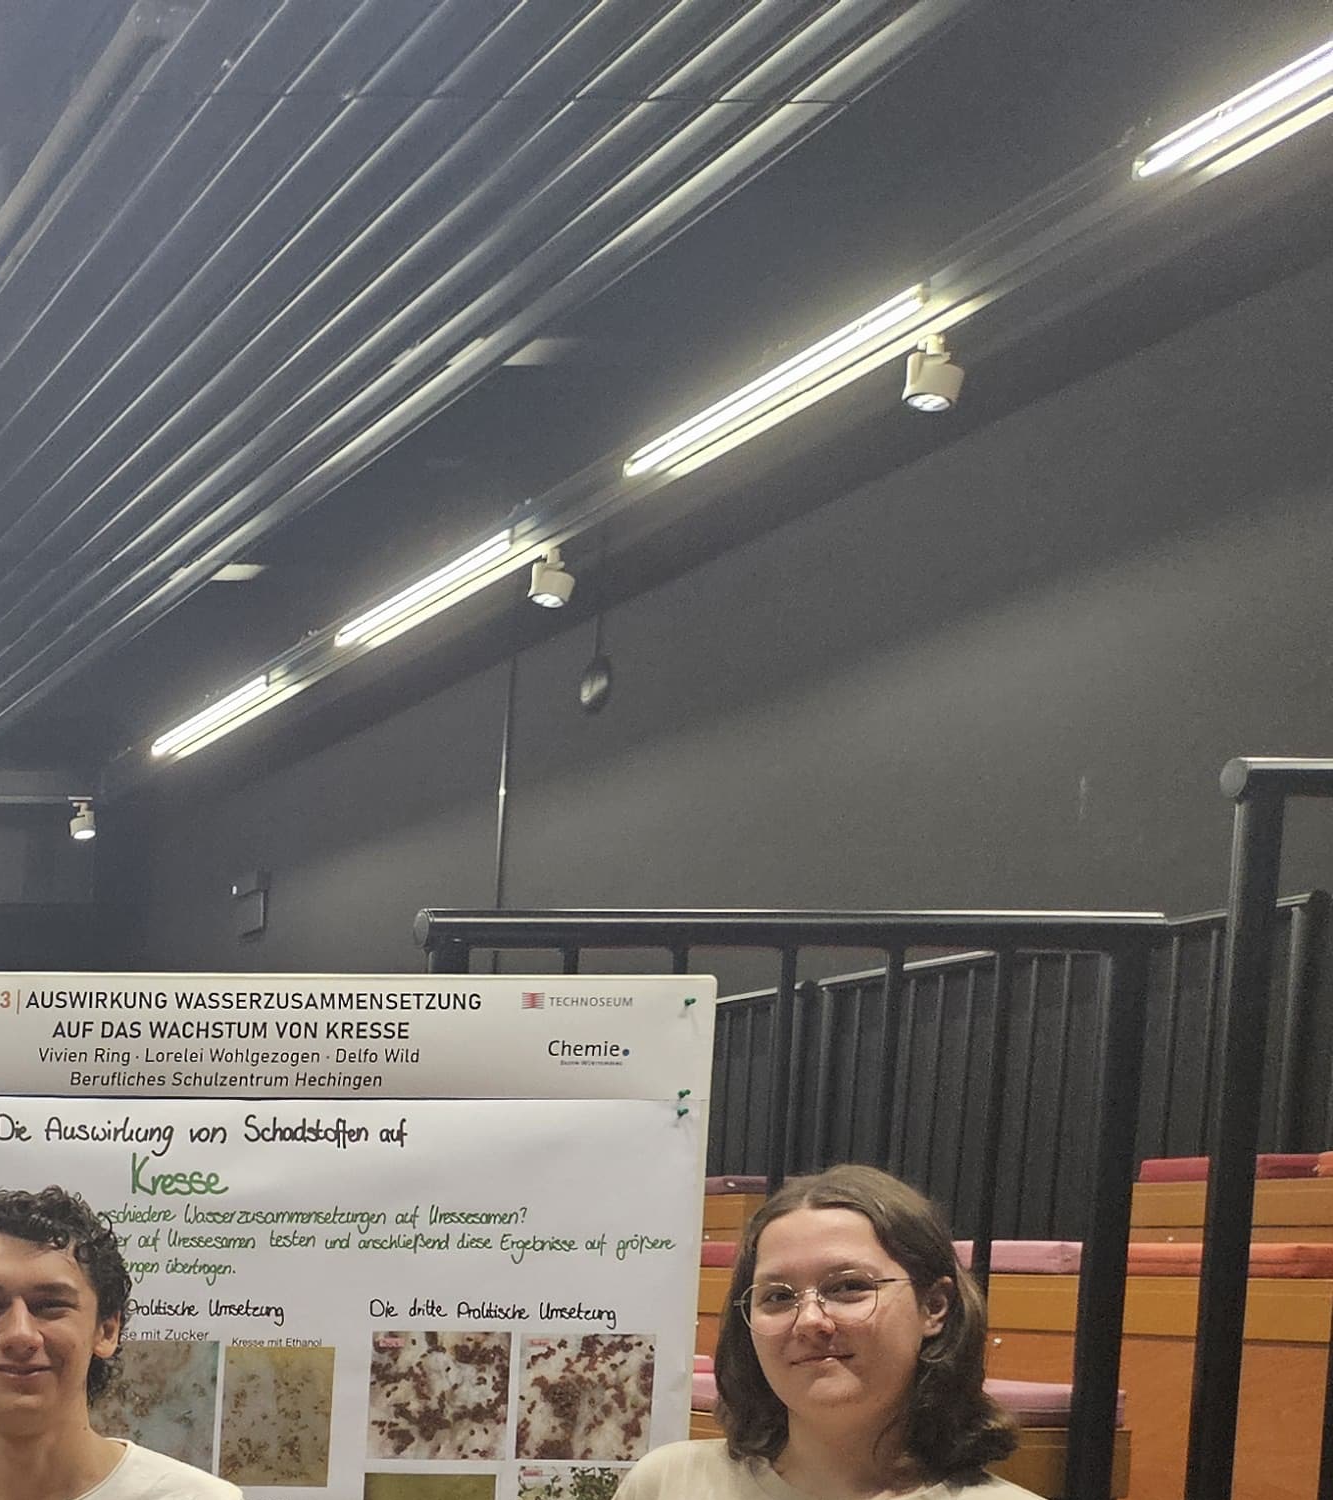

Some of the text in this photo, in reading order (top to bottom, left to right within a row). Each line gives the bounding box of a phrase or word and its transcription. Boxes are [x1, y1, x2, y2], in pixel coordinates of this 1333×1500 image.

[25, 991, 168, 1009] AUSWIRKUNG
[174, 992, 482, 1010] WASSERZUSAMMENSETZUNG
[549, 997, 633, 1007] TECHNOSEUM
[52, 1021, 410, 1039] AUF DAS WACHSTUM VON KRESSE
[38, 1048, 420, 1067] Vivien Ring Lorelei Wohlgezogen Delfo Wild
[70, 1071, 383, 1090] Berufliches Schulzentrum Hechingen
[45, 1116, 175, 1157] Auswirkung
[189, 1126, 228, 1144] von
[244, 1114, 369, 1149] Schadstoffen
[379, 1118, 408, 1148] auf
[131, 1153, 229, 1195] Kresse
[184, 1203, 387, 1234] Wasserzusammensetzungen
[395, 1205, 420, 1229] auf
[138, 1228, 160, 1251] auf
[269, 1230, 316, 1248] testen
[324, 1232, 351, 1250] und
[358, 1232, 450, 1254] anschließend
[456, 1233, 493, 1250] diese
[500, 1233, 578, 1264] Ergebnisse
[585, 1233, 608, 1256] auf
[616, 1233, 677, 1261] größere
[165, 1257, 237, 1286] übertragen.
[208, 1299, 285, 1327] Umsetzung
[370, 1298, 398, 1319] Die
[408, 1298, 448, 1318] dritte
[539, 1302, 617, 1330] Umsetzung
[141, 1329, 209, 1341] mit Zucker
[231, 1337, 323, 1348] Kresse mit Ethanol
